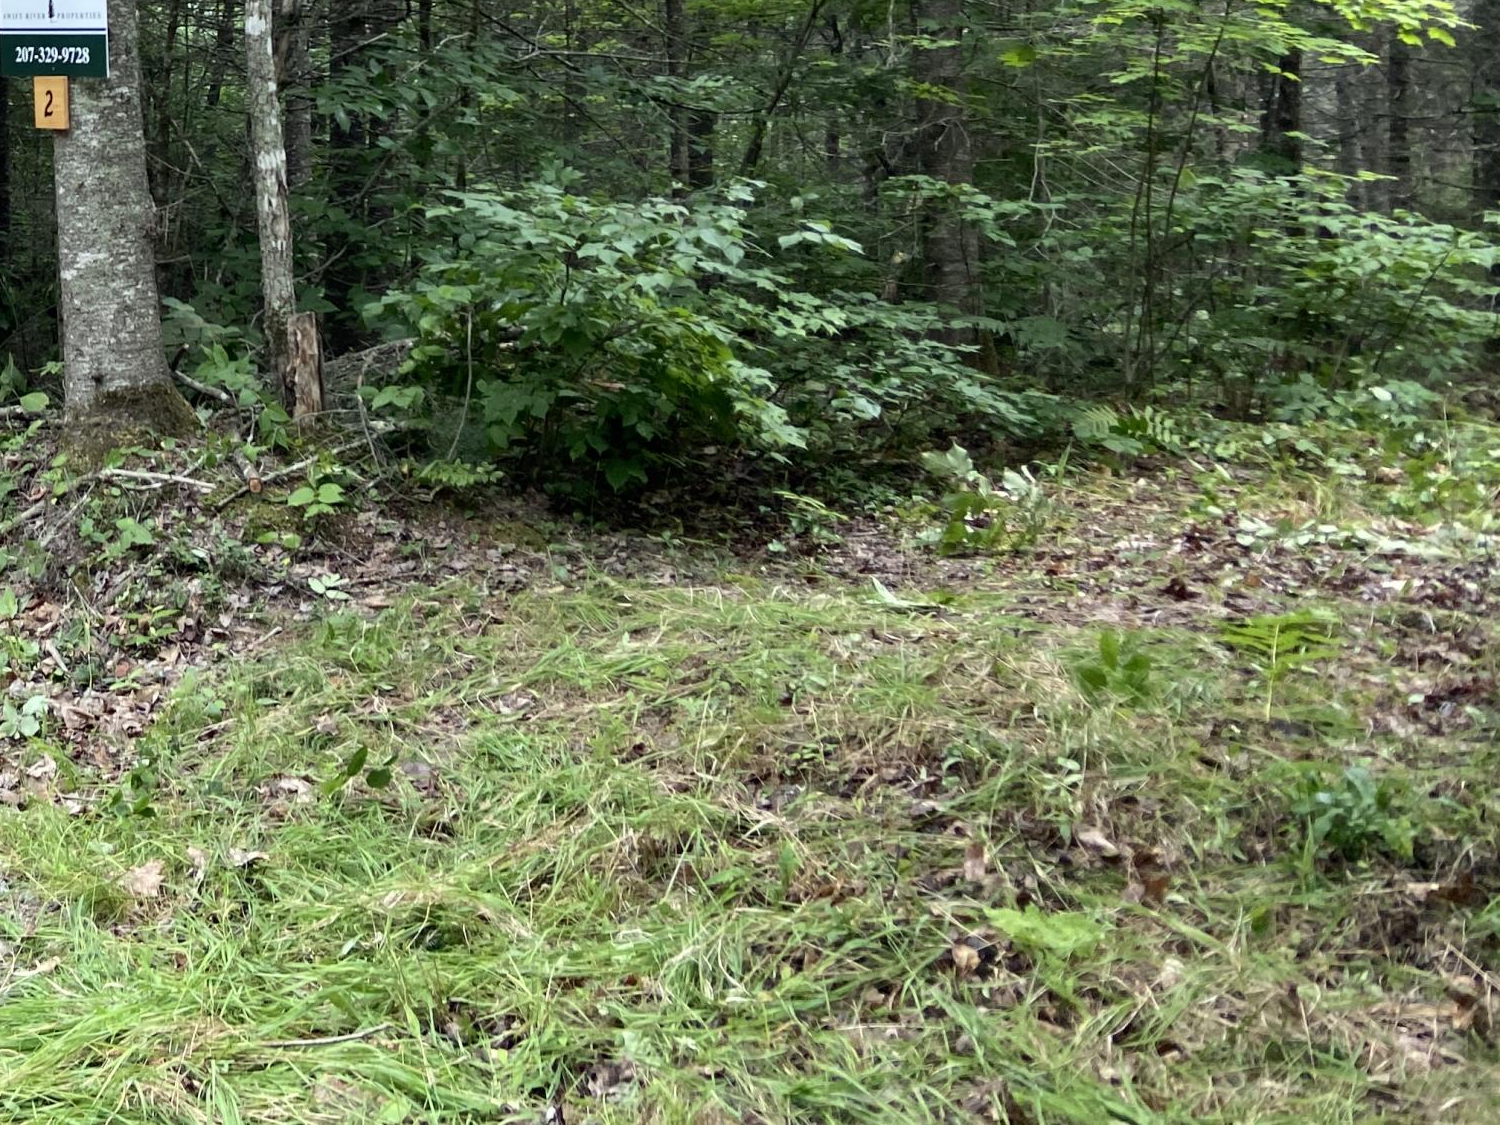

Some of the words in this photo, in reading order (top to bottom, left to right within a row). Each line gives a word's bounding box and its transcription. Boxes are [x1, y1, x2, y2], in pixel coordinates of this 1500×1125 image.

[26, 12, 46, 20] RIVER
[56, 11, 101, 20] PROPERTIES
[15, 46, 90, 64] 207-329-9728
[44, 89, 54, 118] 2
